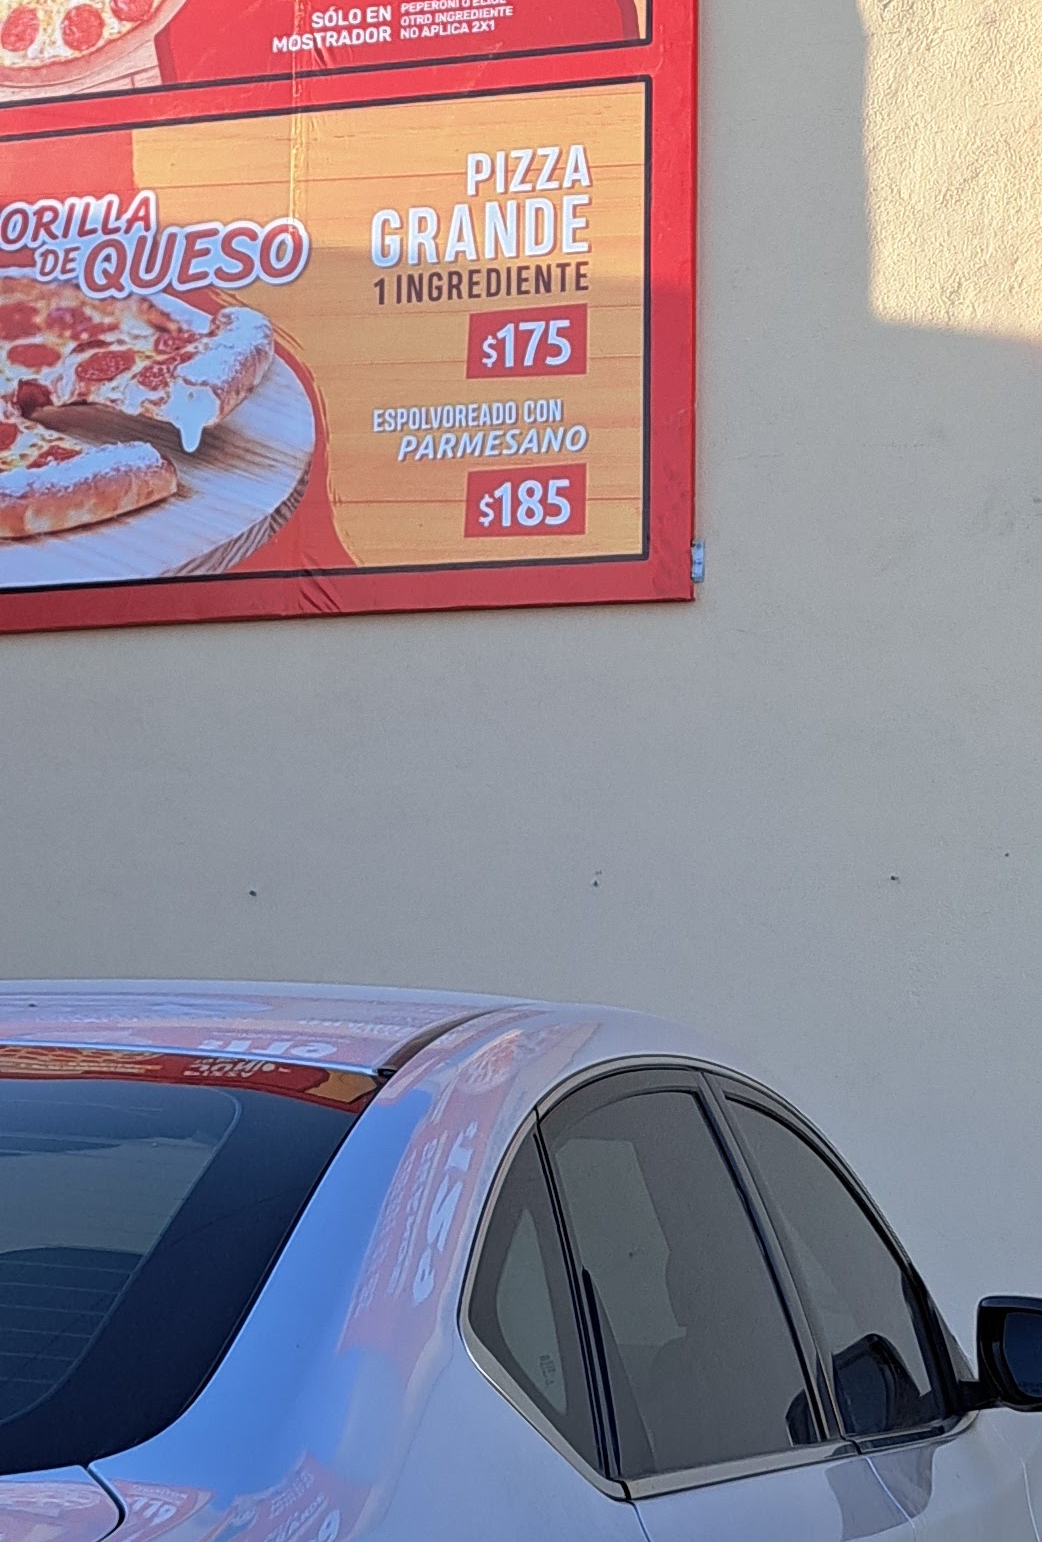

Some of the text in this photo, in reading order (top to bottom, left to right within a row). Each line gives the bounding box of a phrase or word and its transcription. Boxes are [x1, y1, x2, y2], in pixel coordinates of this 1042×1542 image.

[311, 5, 392, 28] SÓLO EN
[400, 5, 514, 26] OTRO INGREDIENTE
[400, 20, 496, 39] NO APLICA 2X1
[272, 26, 392, 53] MOSTRADOR
[466, 144, 591, 196] PIZZA
[0, 194, 154, 246] ORILLA
[370, 194, 590, 268] GRANDE
[39, 223, 304, 293] DE QUESO
[373, 261, 590, 305] 1 INGREDIENTE
[482, 319, 572, 368] $175
[373, 398, 563, 432] ESPOLVOREADO CON
[397, 425, 588, 462] PARMESANO
[479, 478, 571, 527] $185
